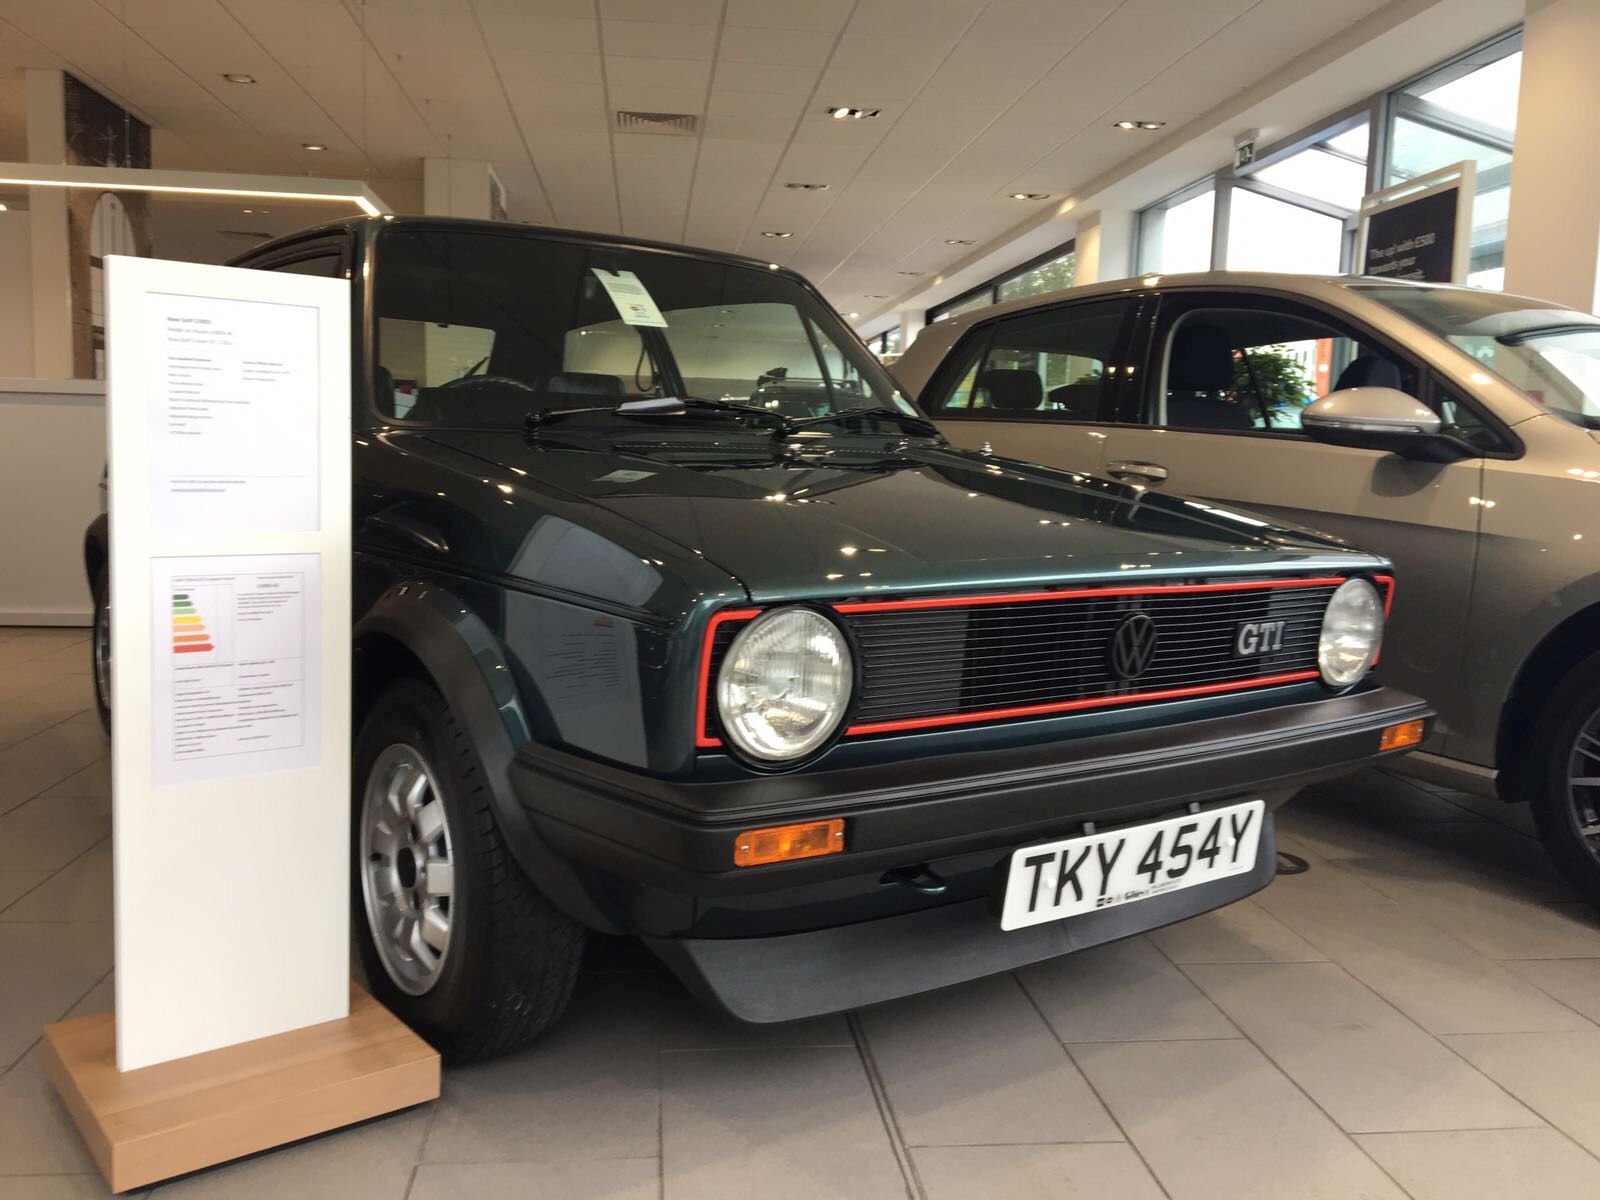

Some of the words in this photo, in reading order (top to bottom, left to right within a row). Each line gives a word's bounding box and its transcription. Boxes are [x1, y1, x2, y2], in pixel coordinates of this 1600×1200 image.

[1238, 621, 1285, 655] GTI
[1025, 838, 1126, 913] TKY
[1137, 810, 1254, 884] 454Y
